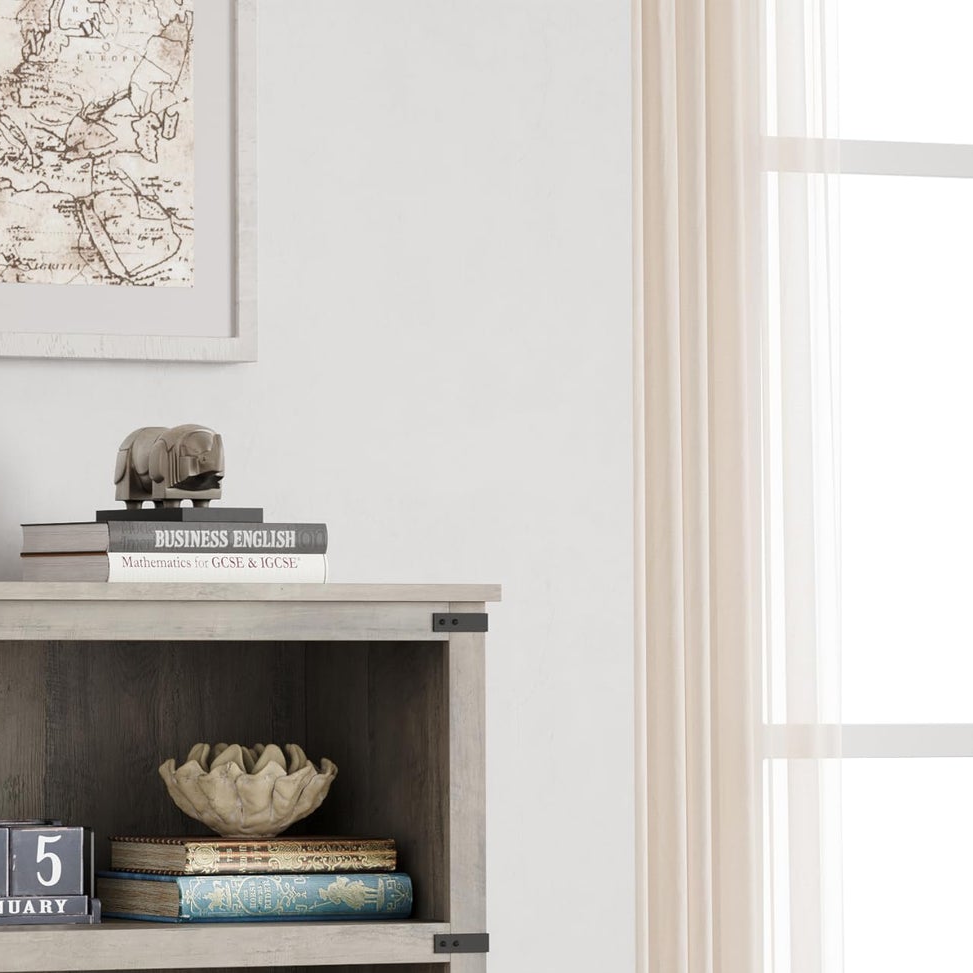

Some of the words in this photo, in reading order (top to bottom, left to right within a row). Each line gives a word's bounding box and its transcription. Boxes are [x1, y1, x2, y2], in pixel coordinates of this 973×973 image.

[155, 530, 229, 548] BUSINESS
[233, 530, 296, 548] ENGLISH
[122, 556, 192, 568] Mathematics
[195, 556, 209, 568] for
[211, 556, 245, 568] GCSE
[248, 557, 257, 568] &
[36, 834, 63, 887] 5
